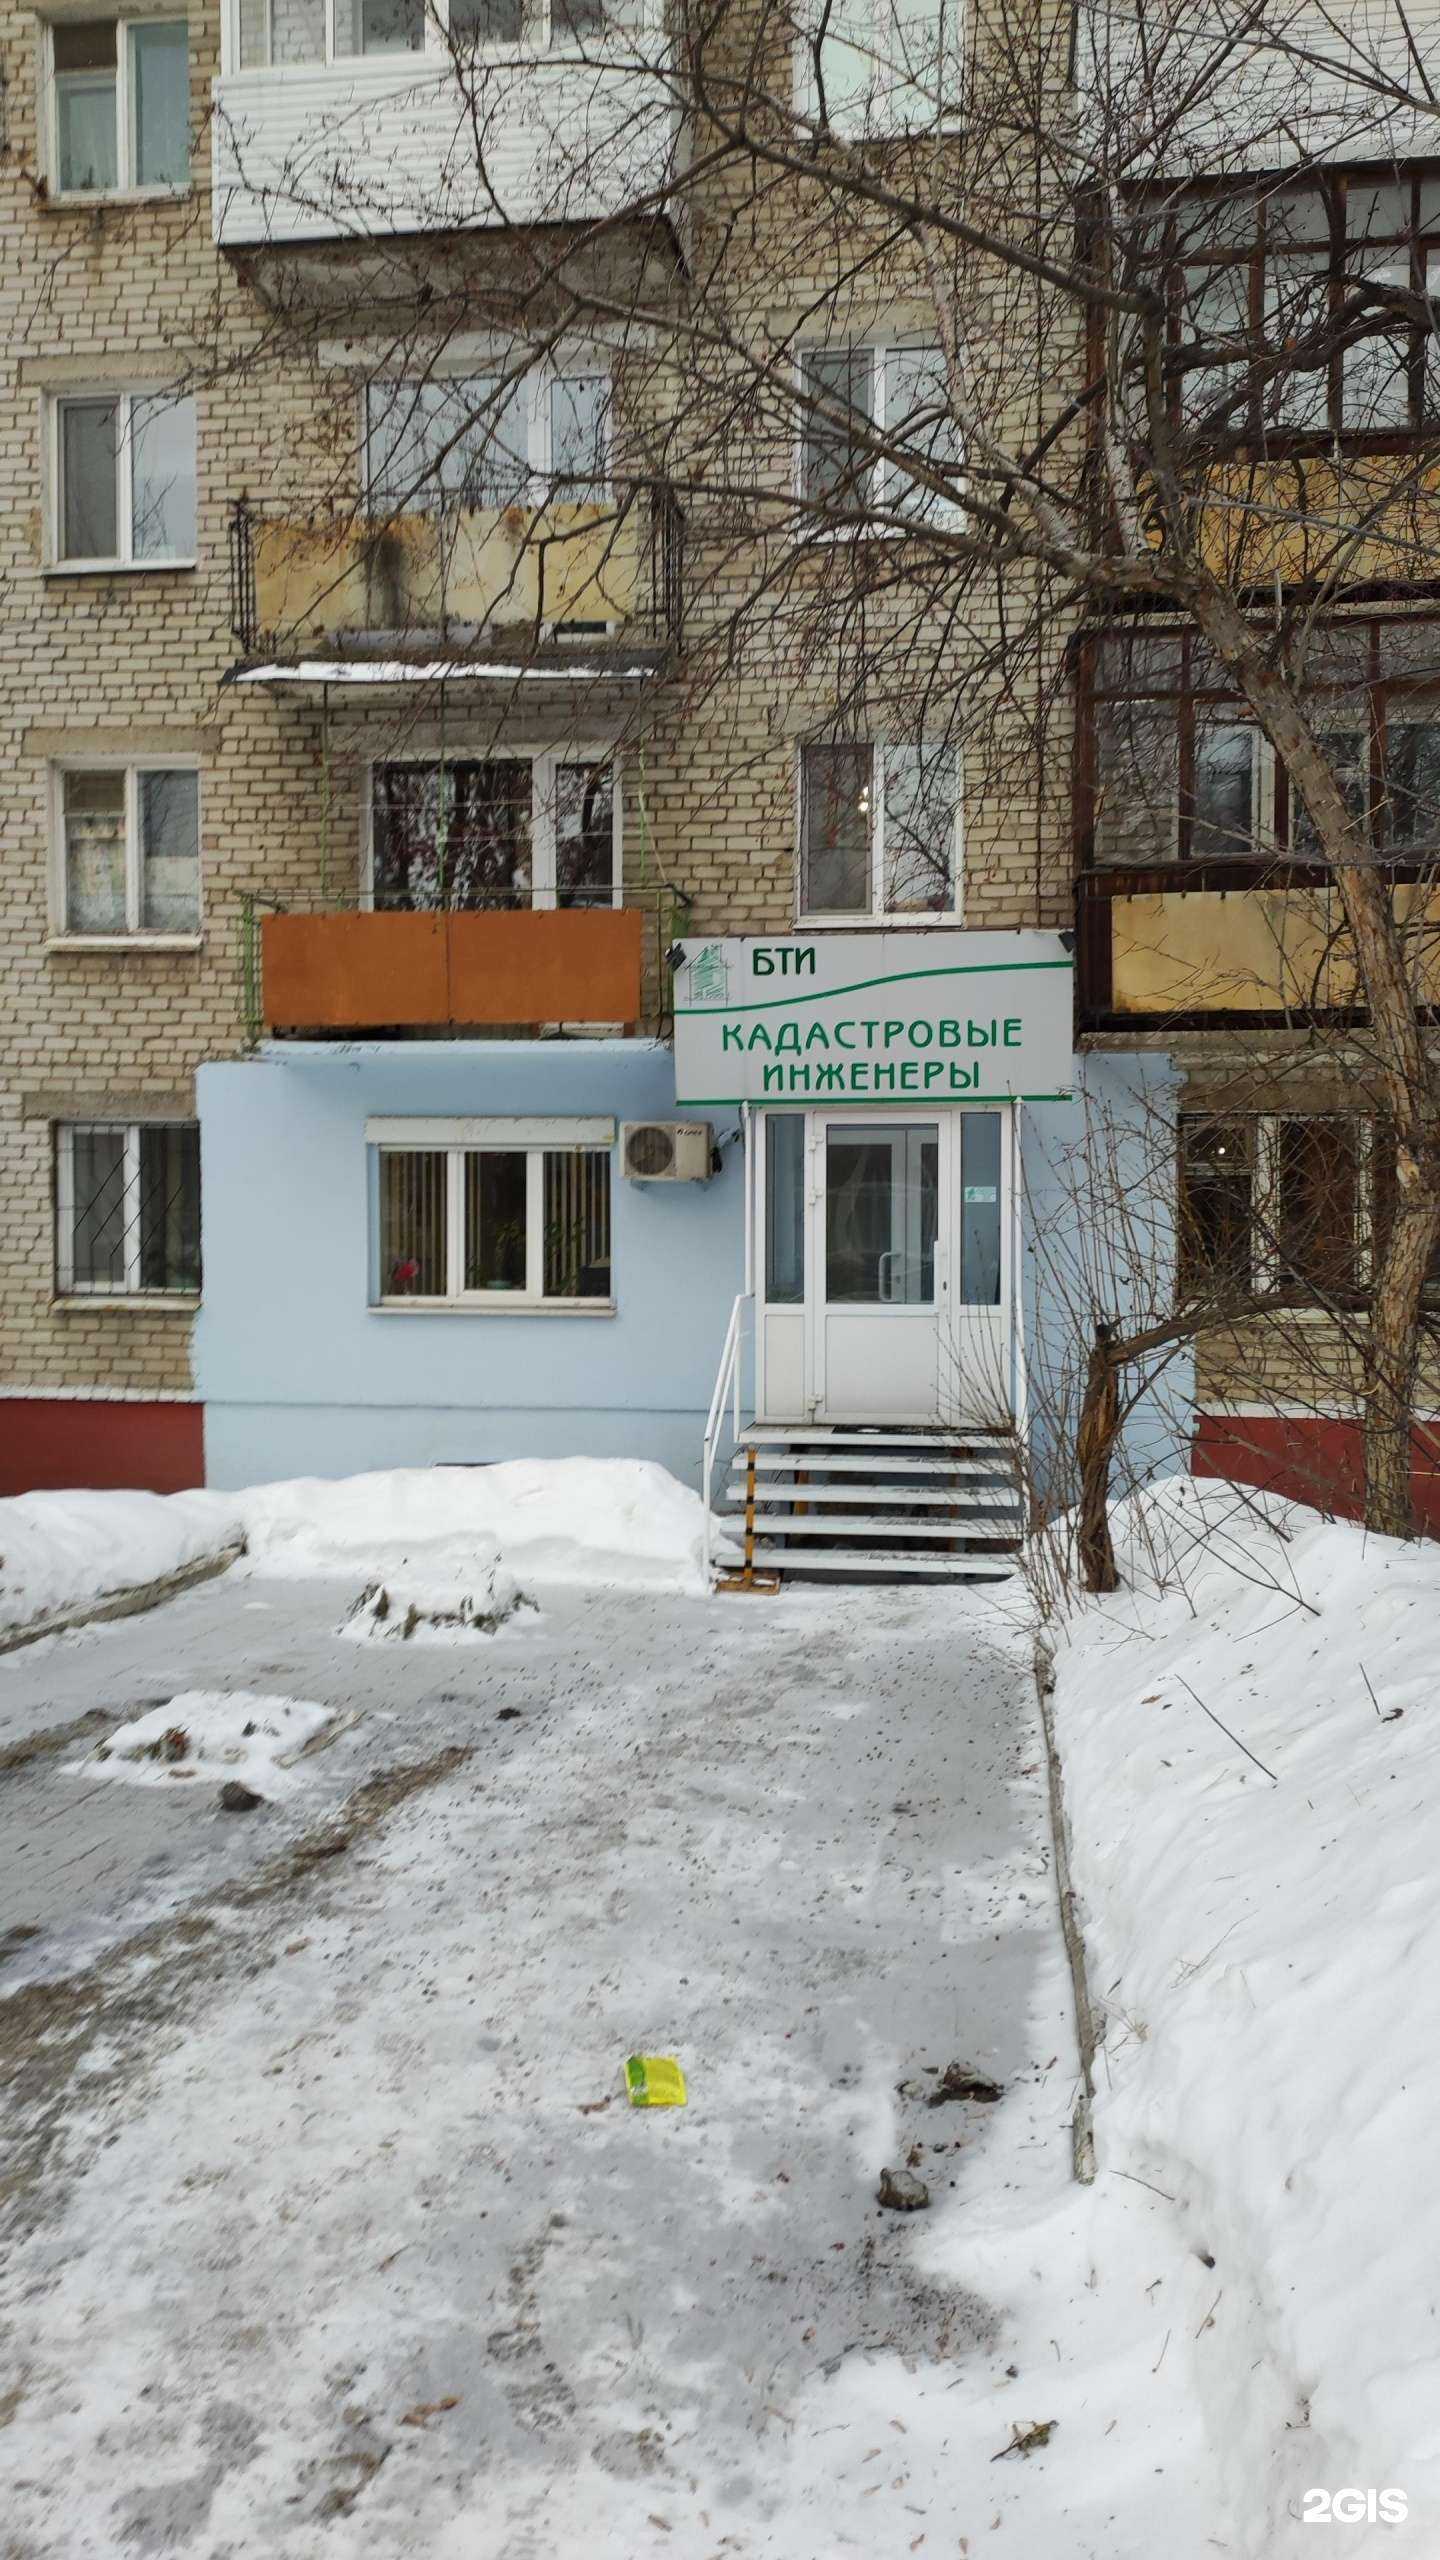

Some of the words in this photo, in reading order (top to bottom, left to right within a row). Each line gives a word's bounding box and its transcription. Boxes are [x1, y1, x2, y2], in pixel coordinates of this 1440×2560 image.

[752, 947, 816, 976] БТИ
[722, 1018, 1023, 1056] КАДАСТРОВЫЕ
[763, 1061, 980, 1091] ИНЖЕНЕРЫ
